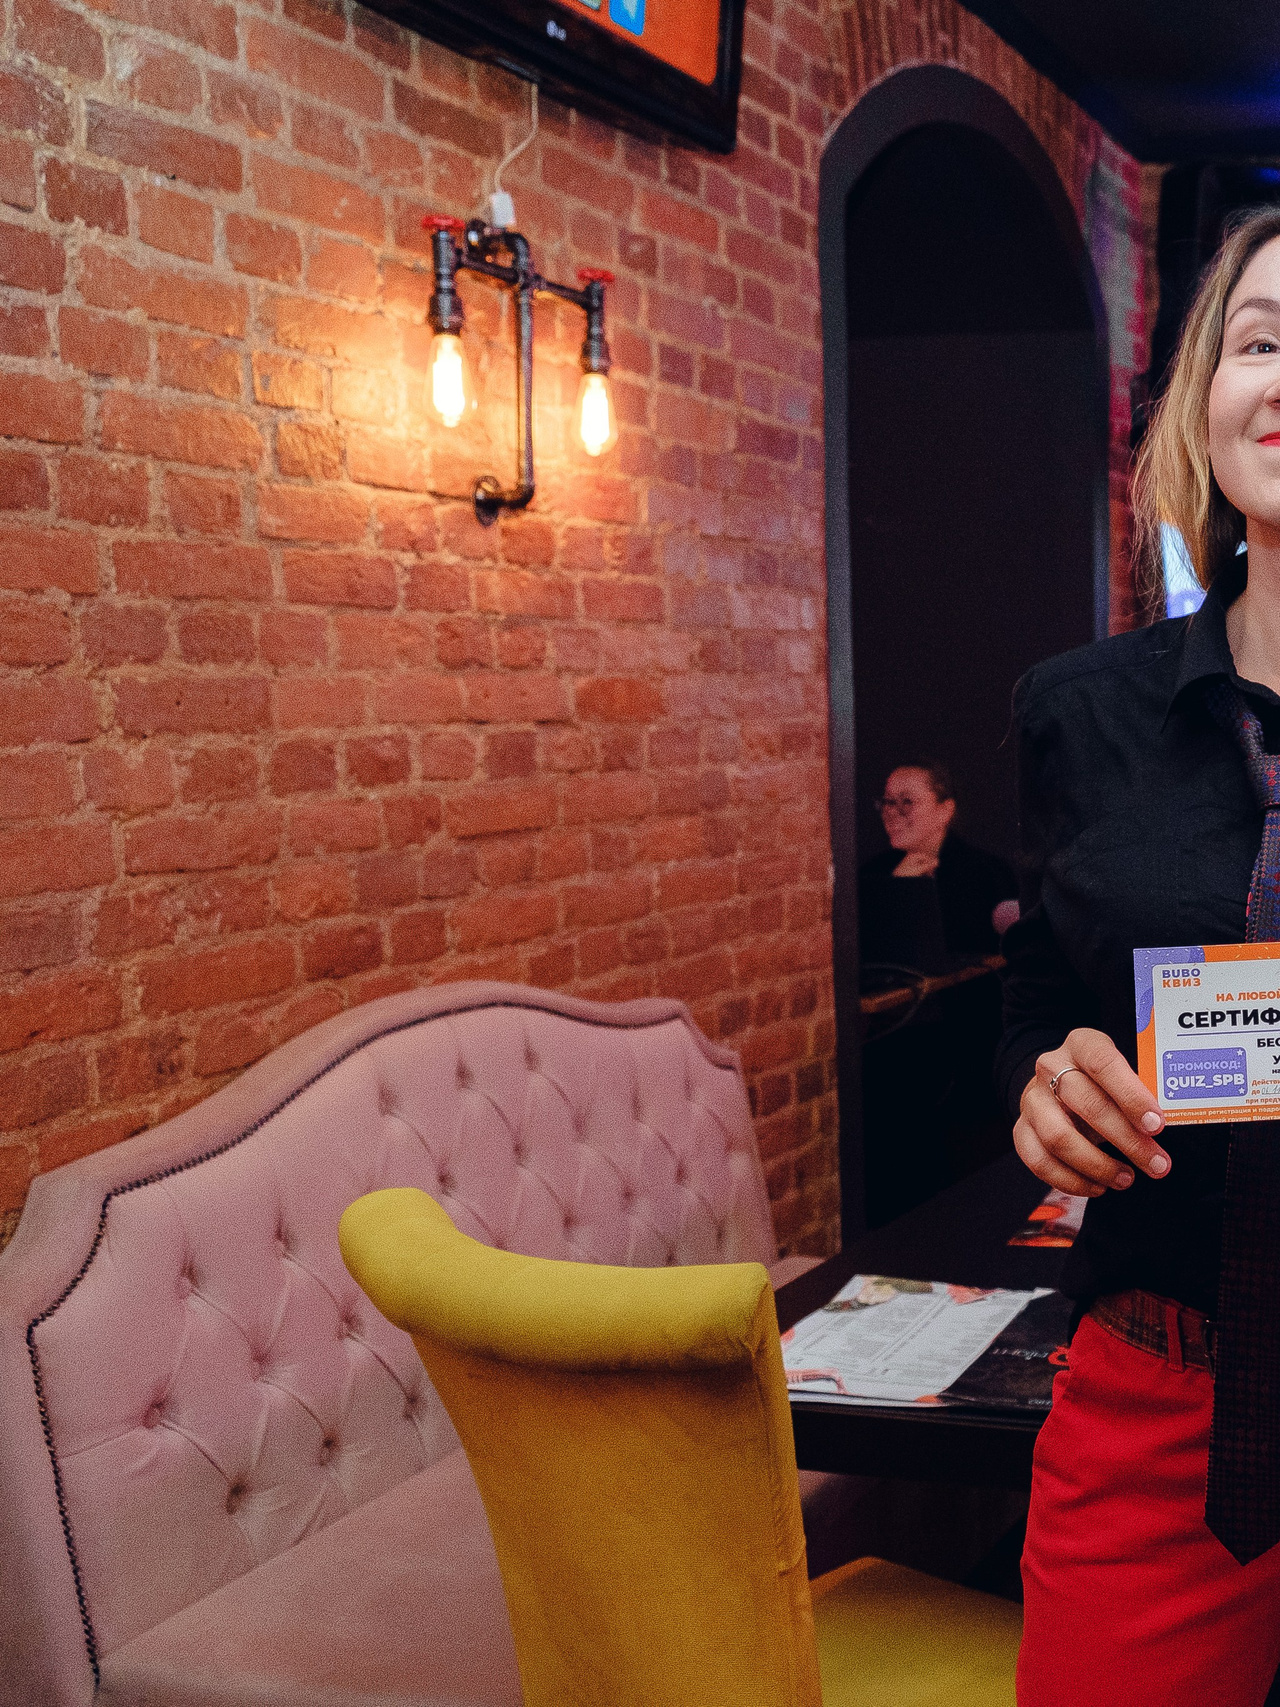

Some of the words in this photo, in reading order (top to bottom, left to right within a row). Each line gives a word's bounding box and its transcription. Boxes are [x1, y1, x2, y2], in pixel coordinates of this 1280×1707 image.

[1162, 968, 1201, 979] BUBO
[1162, 978, 1201, 988] КВИЗ
[1216, 992, 1234, 1002] НА
[1169, 1061, 1241, 1071] ПРОМОКОД:
[1166, 1073, 1245, 1091] QUIZ_SPB
